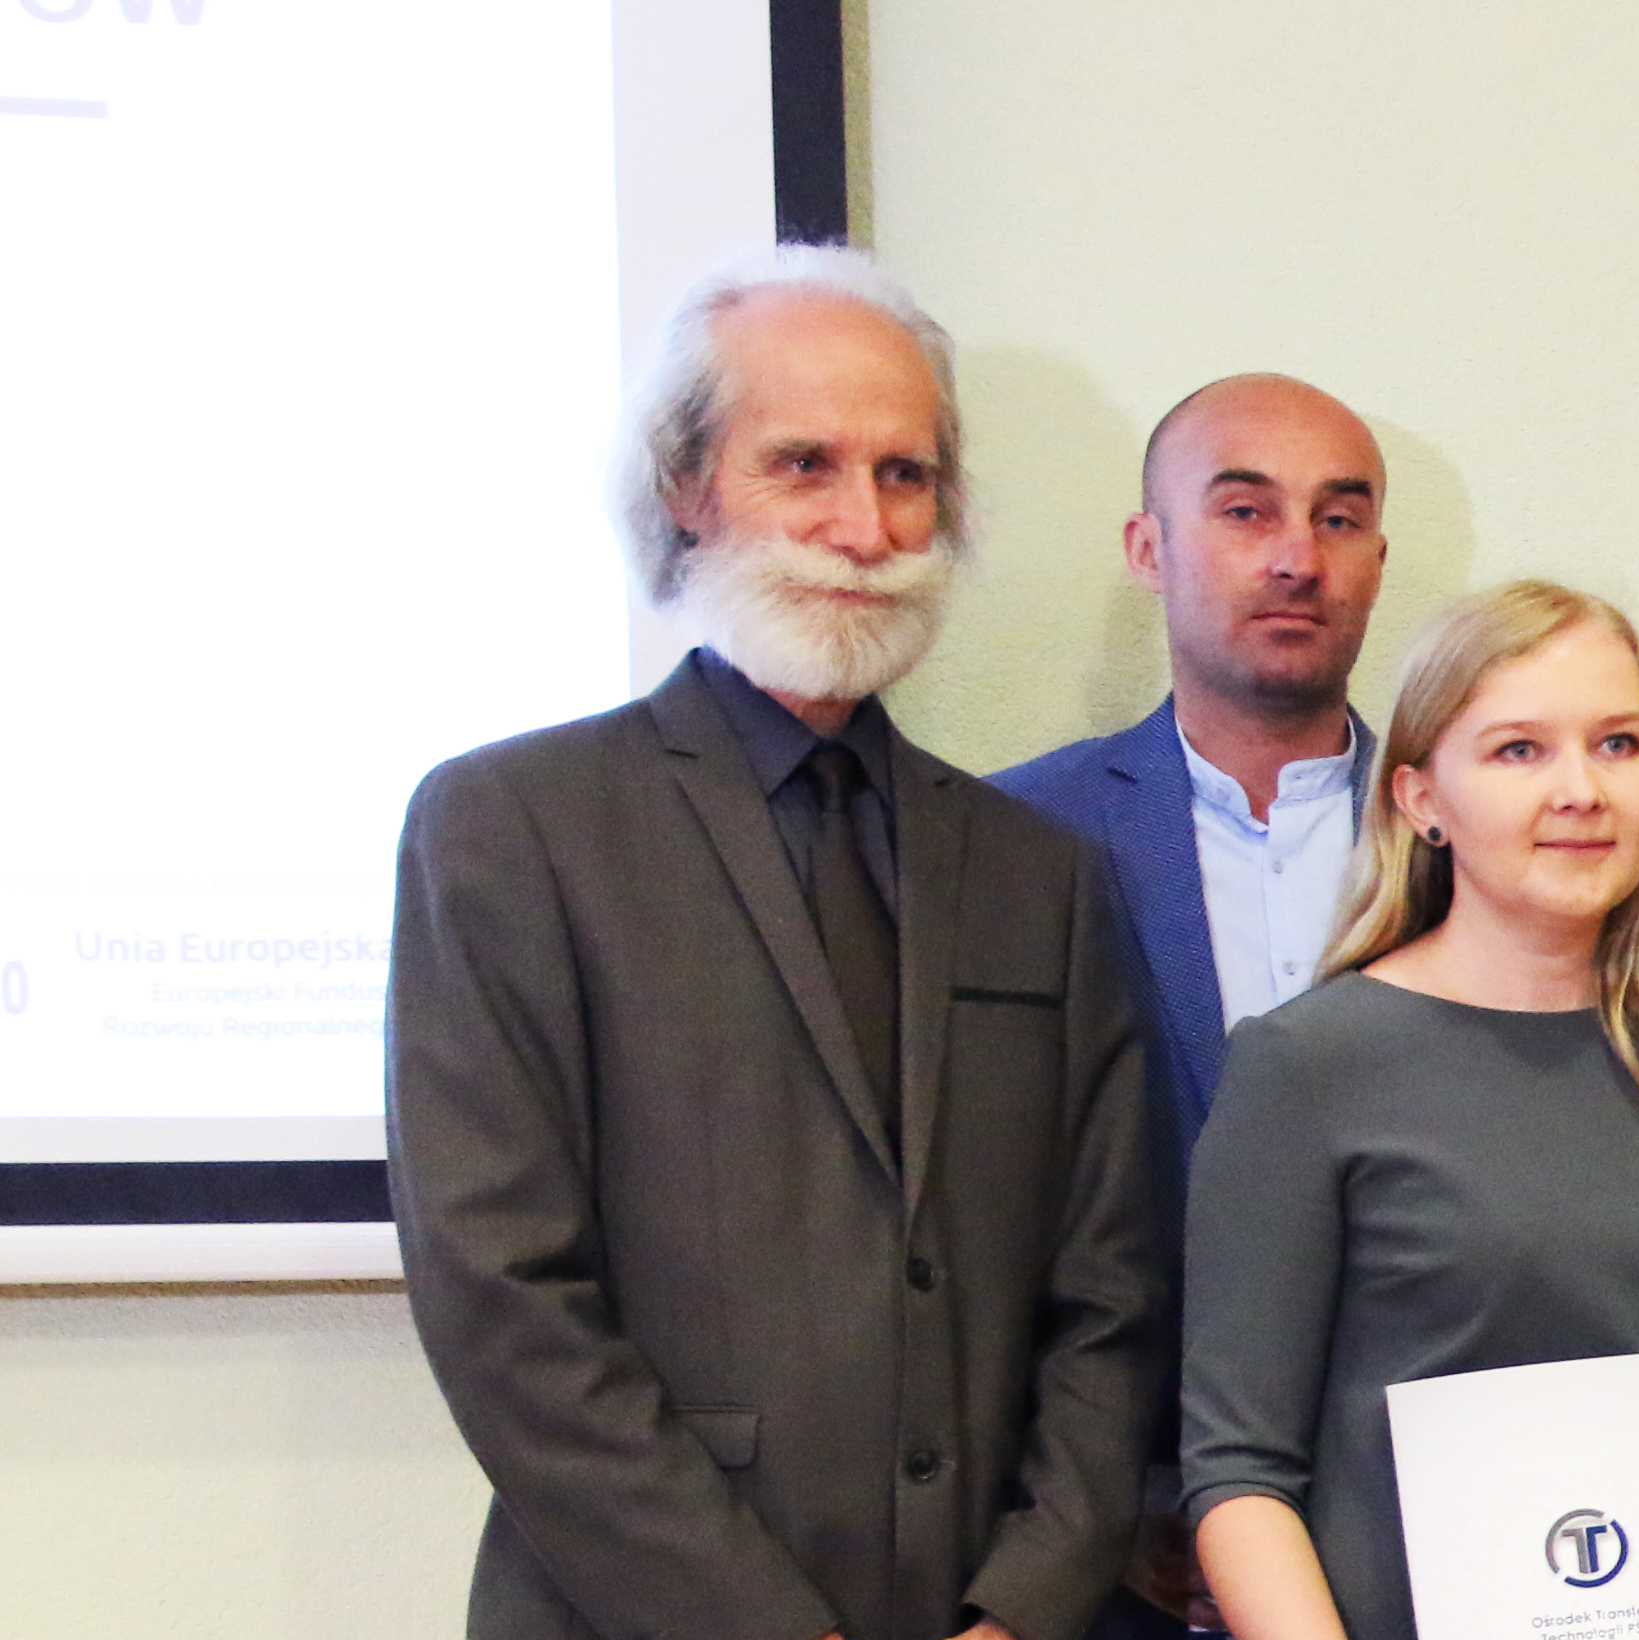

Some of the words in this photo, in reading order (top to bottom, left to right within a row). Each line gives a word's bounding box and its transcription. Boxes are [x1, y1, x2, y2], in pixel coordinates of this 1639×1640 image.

[75, 930, 166, 963] Unia
[293, 979, 385, 1003] Fundus
[222, 1013, 384, 1041] Regionalneg
